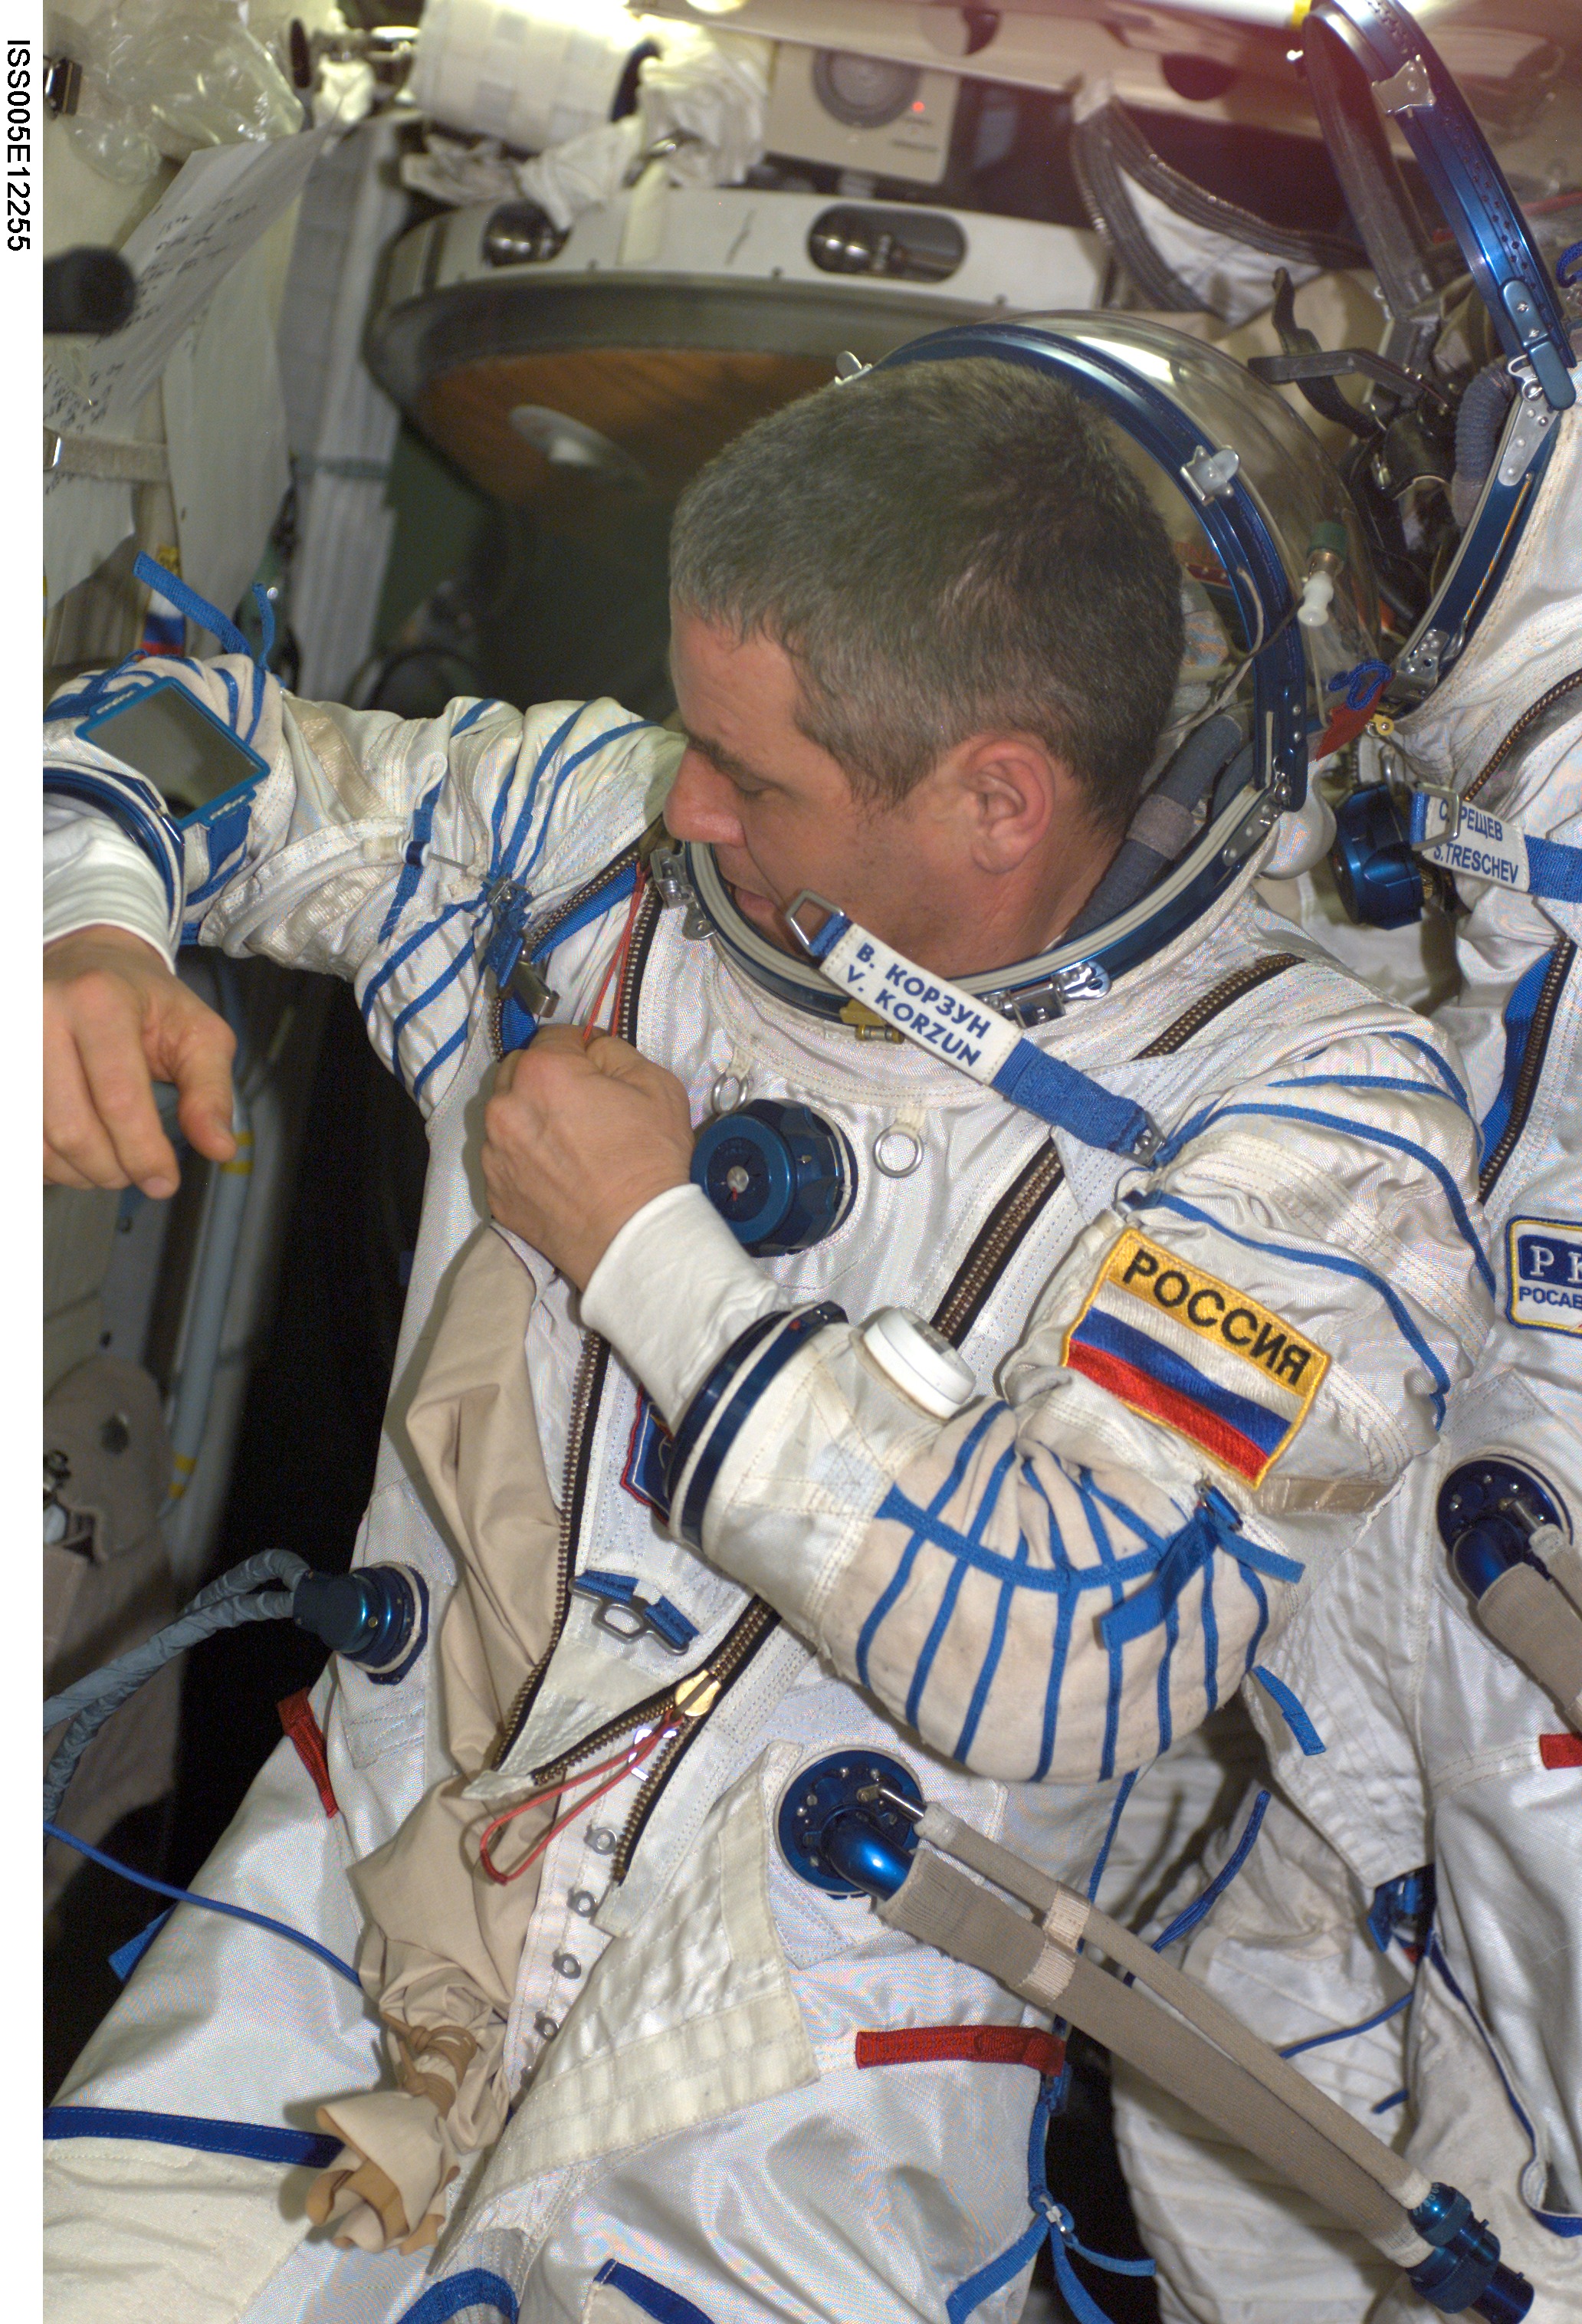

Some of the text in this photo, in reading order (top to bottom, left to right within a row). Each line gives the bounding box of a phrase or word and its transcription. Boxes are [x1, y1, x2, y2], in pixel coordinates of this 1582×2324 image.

[847, 965, 981, 1067] V. KORZUN
[855, 942, 992, 1040] В. КОРЗУН
[1121, 1248, 1312, 1387] РОССИЯ
